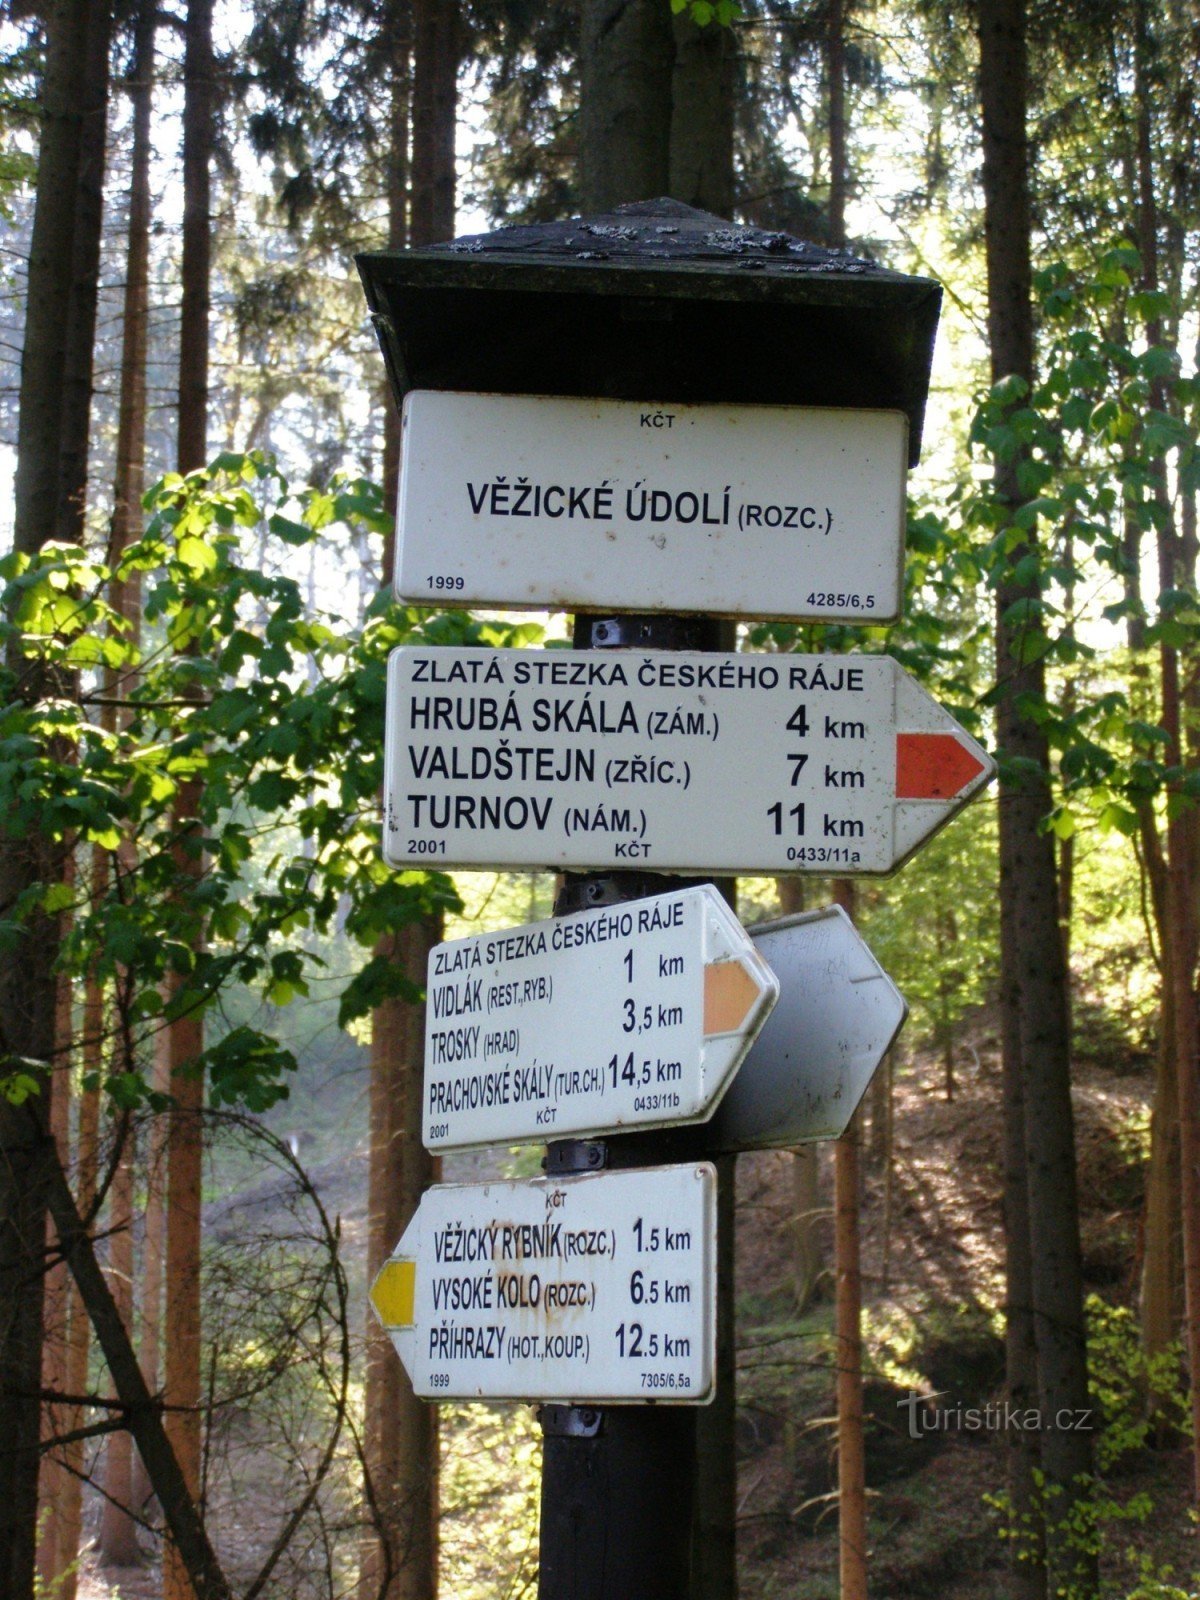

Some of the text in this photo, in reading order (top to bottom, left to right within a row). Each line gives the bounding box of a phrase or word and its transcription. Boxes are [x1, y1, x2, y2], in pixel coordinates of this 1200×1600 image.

[640, 411, 675, 428] KČT
[466, 477, 833, 534] VĚŽICKÉ ÚDOLÍ (ROZC.)
[426, 576, 464, 590] 1999
[807, 593, 874, 610] 4285/6,5
[412, 655, 864, 691] ZLATÁ STEZKA ČESKÉHO RÁJE
[410, 691, 864, 740] HRUBÁ SKÁLA (ZÁM.) 4 km
[409, 740, 864, 789] VALDŠTEJN (ZŘÍC.) 7 km
[408, 796, 864, 837] TURNOV (NÁM.) 11 km
[408, 840, 446, 854] 2001
[614, 840, 652, 858] KČT
[787, 846, 861, 863] 0433/11a
[435, 903, 684, 975] ZLATÁ STEZKA ČESKÉHO RÁJE
[433, 974, 483, 1019] VIDLÁK
[624, 949, 634, 983] 1
[659, 954, 684, 976] km
[432, 998, 683, 1064] TROSKY (HRAD) 3,5 km
[430, 1052, 682, 1114] PRACHOVSKÉ SKÁLY (TUR.CH.) 14,5 km
[536, 1107, 557, 1125] KČT
[634, 1094, 680, 1112] 0433/11b
[430, 1125, 449, 1139] 2001
[546, 1192, 567, 1208] KČT
[435, 1212, 690, 1262] VĚŽICKÝ RYBNÍK (ROZC.) 1.5 km
[432, 1269, 690, 1311] VYSOKÉ KOLO (ROZC.) 6.5 km
[429, 1319, 505, 1360] PŘÍHRAZY
[615, 1323, 658, 1358] 12.5
[665, 1336, 690, 1357] km
[429, 1374, 450, 1387] 1999
[641, 1374, 690, 1389] 7305/6,5a
